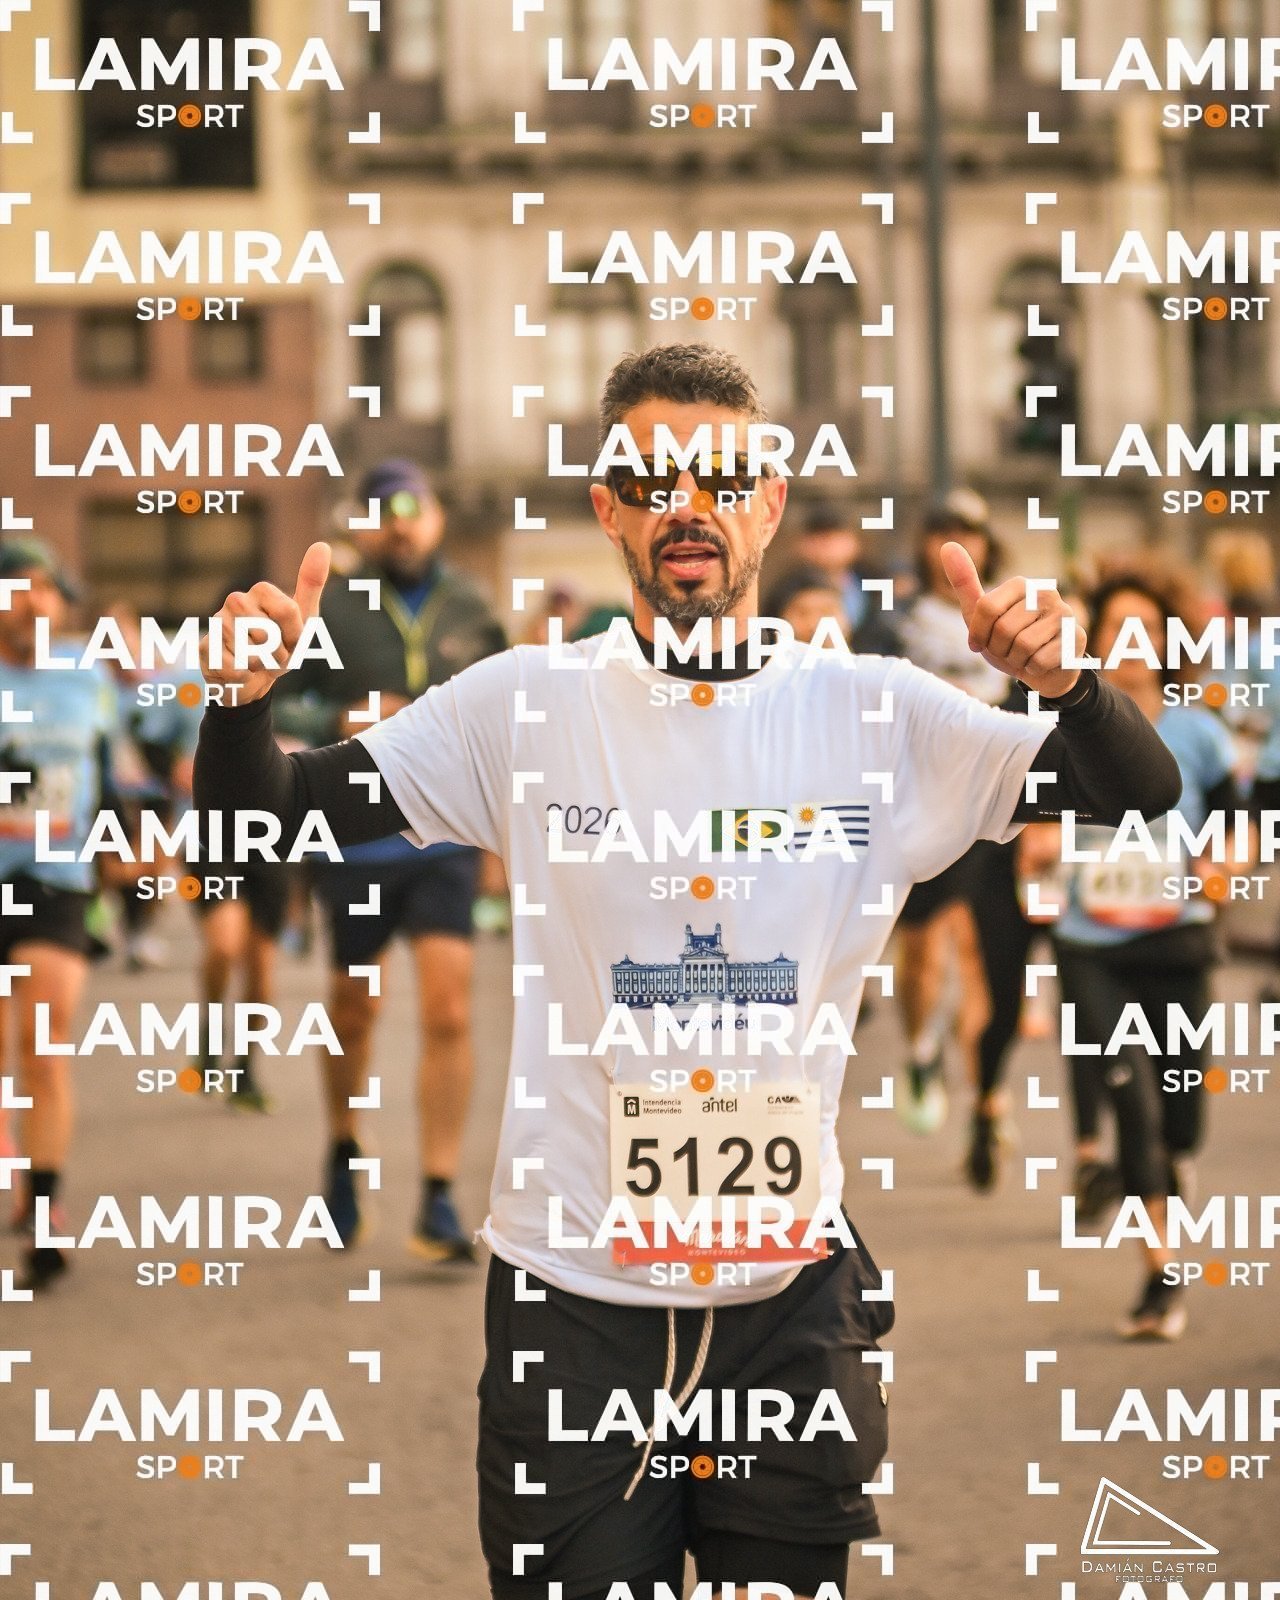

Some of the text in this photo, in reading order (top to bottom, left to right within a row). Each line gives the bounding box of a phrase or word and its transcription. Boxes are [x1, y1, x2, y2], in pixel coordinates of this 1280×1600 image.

[642, 1107, 683, 1115] Montevideo
[701, 1097, 738, 1113] antel
[625, 1136, 803, 1197] 5129
